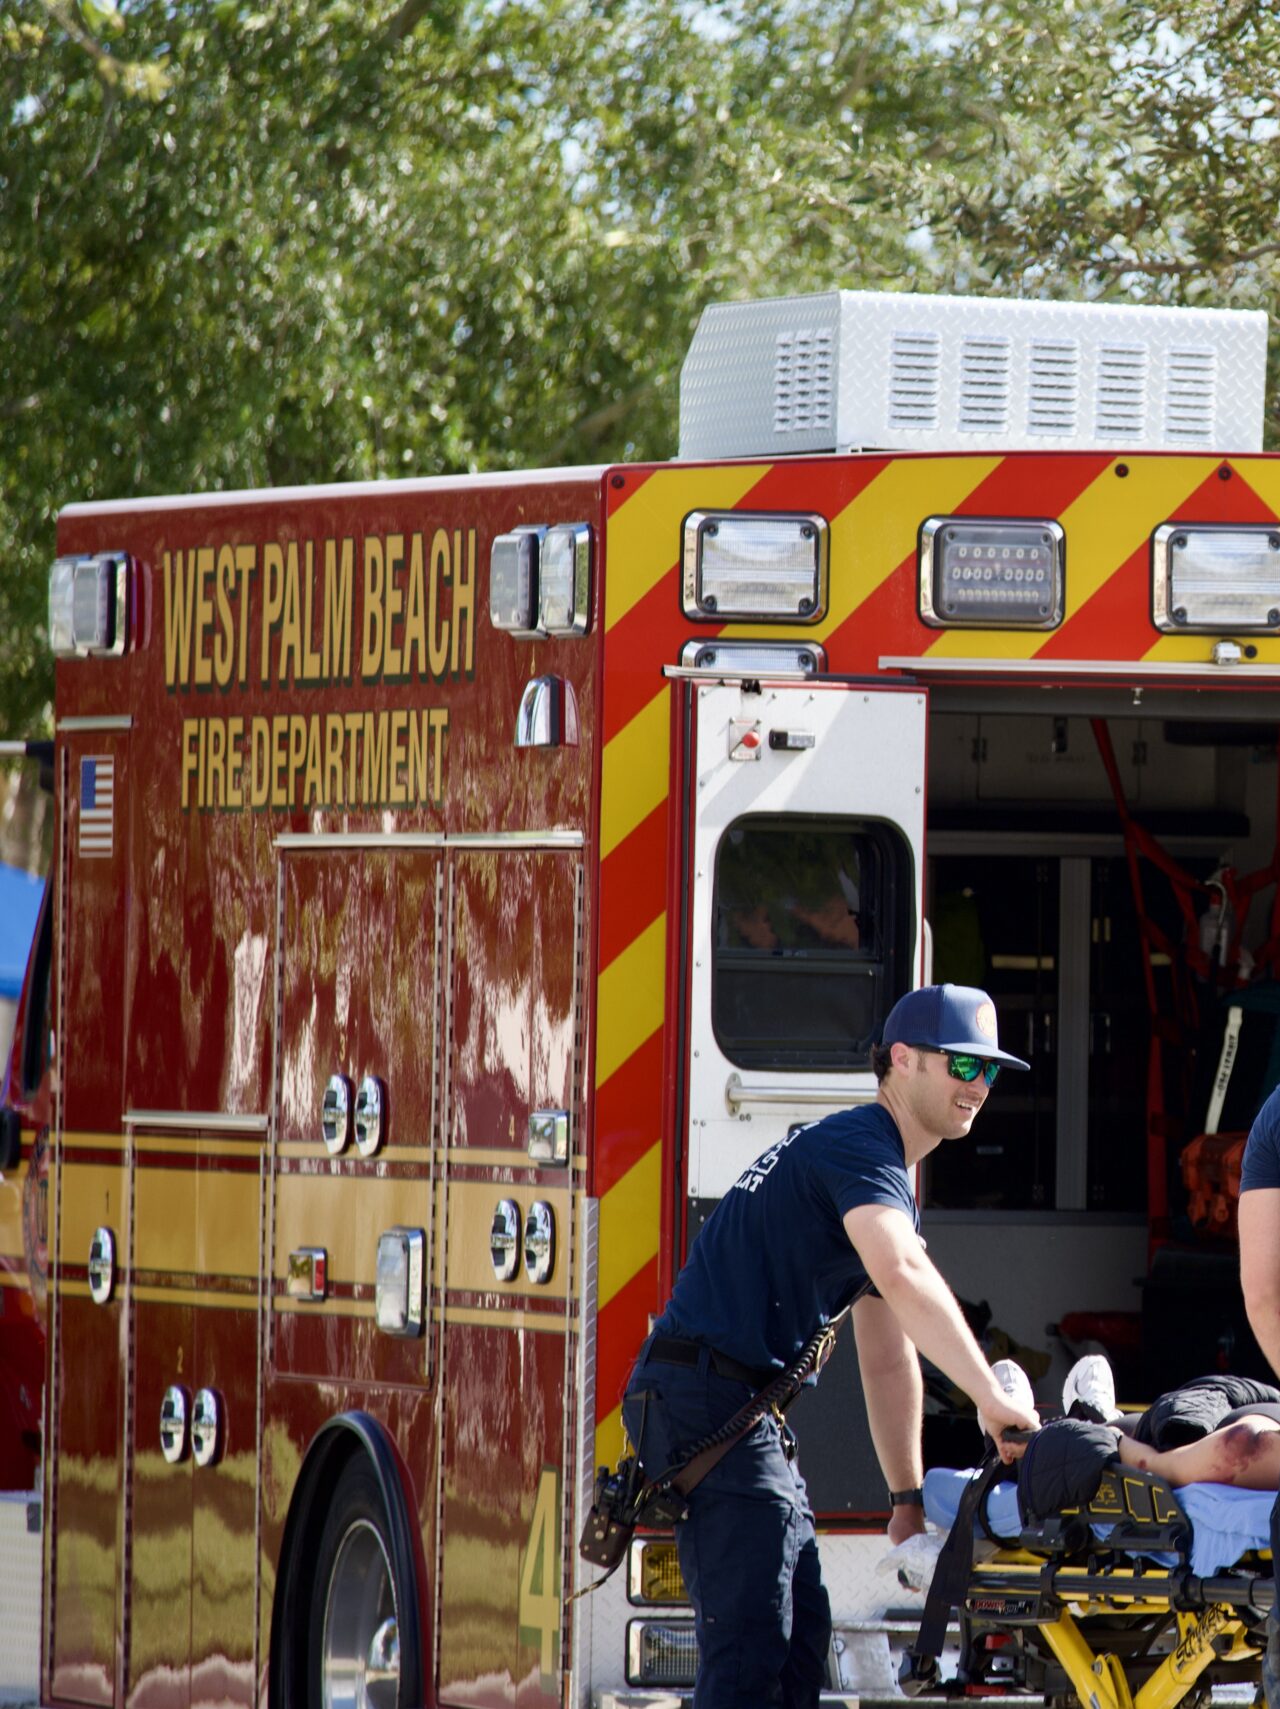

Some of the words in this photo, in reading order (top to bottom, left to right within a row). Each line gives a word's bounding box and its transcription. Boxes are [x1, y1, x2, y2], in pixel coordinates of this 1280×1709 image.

[163, 543, 257, 688] WEST
[260, 537, 355, 683] PALM
[361, 528, 477, 679] BEACH
[180, 716, 245, 809] FIRE
[250, 708, 449, 808] DEPARTMENT
[177, 1345, 184, 1373] 2
[519, 1469, 560, 1676] 4
